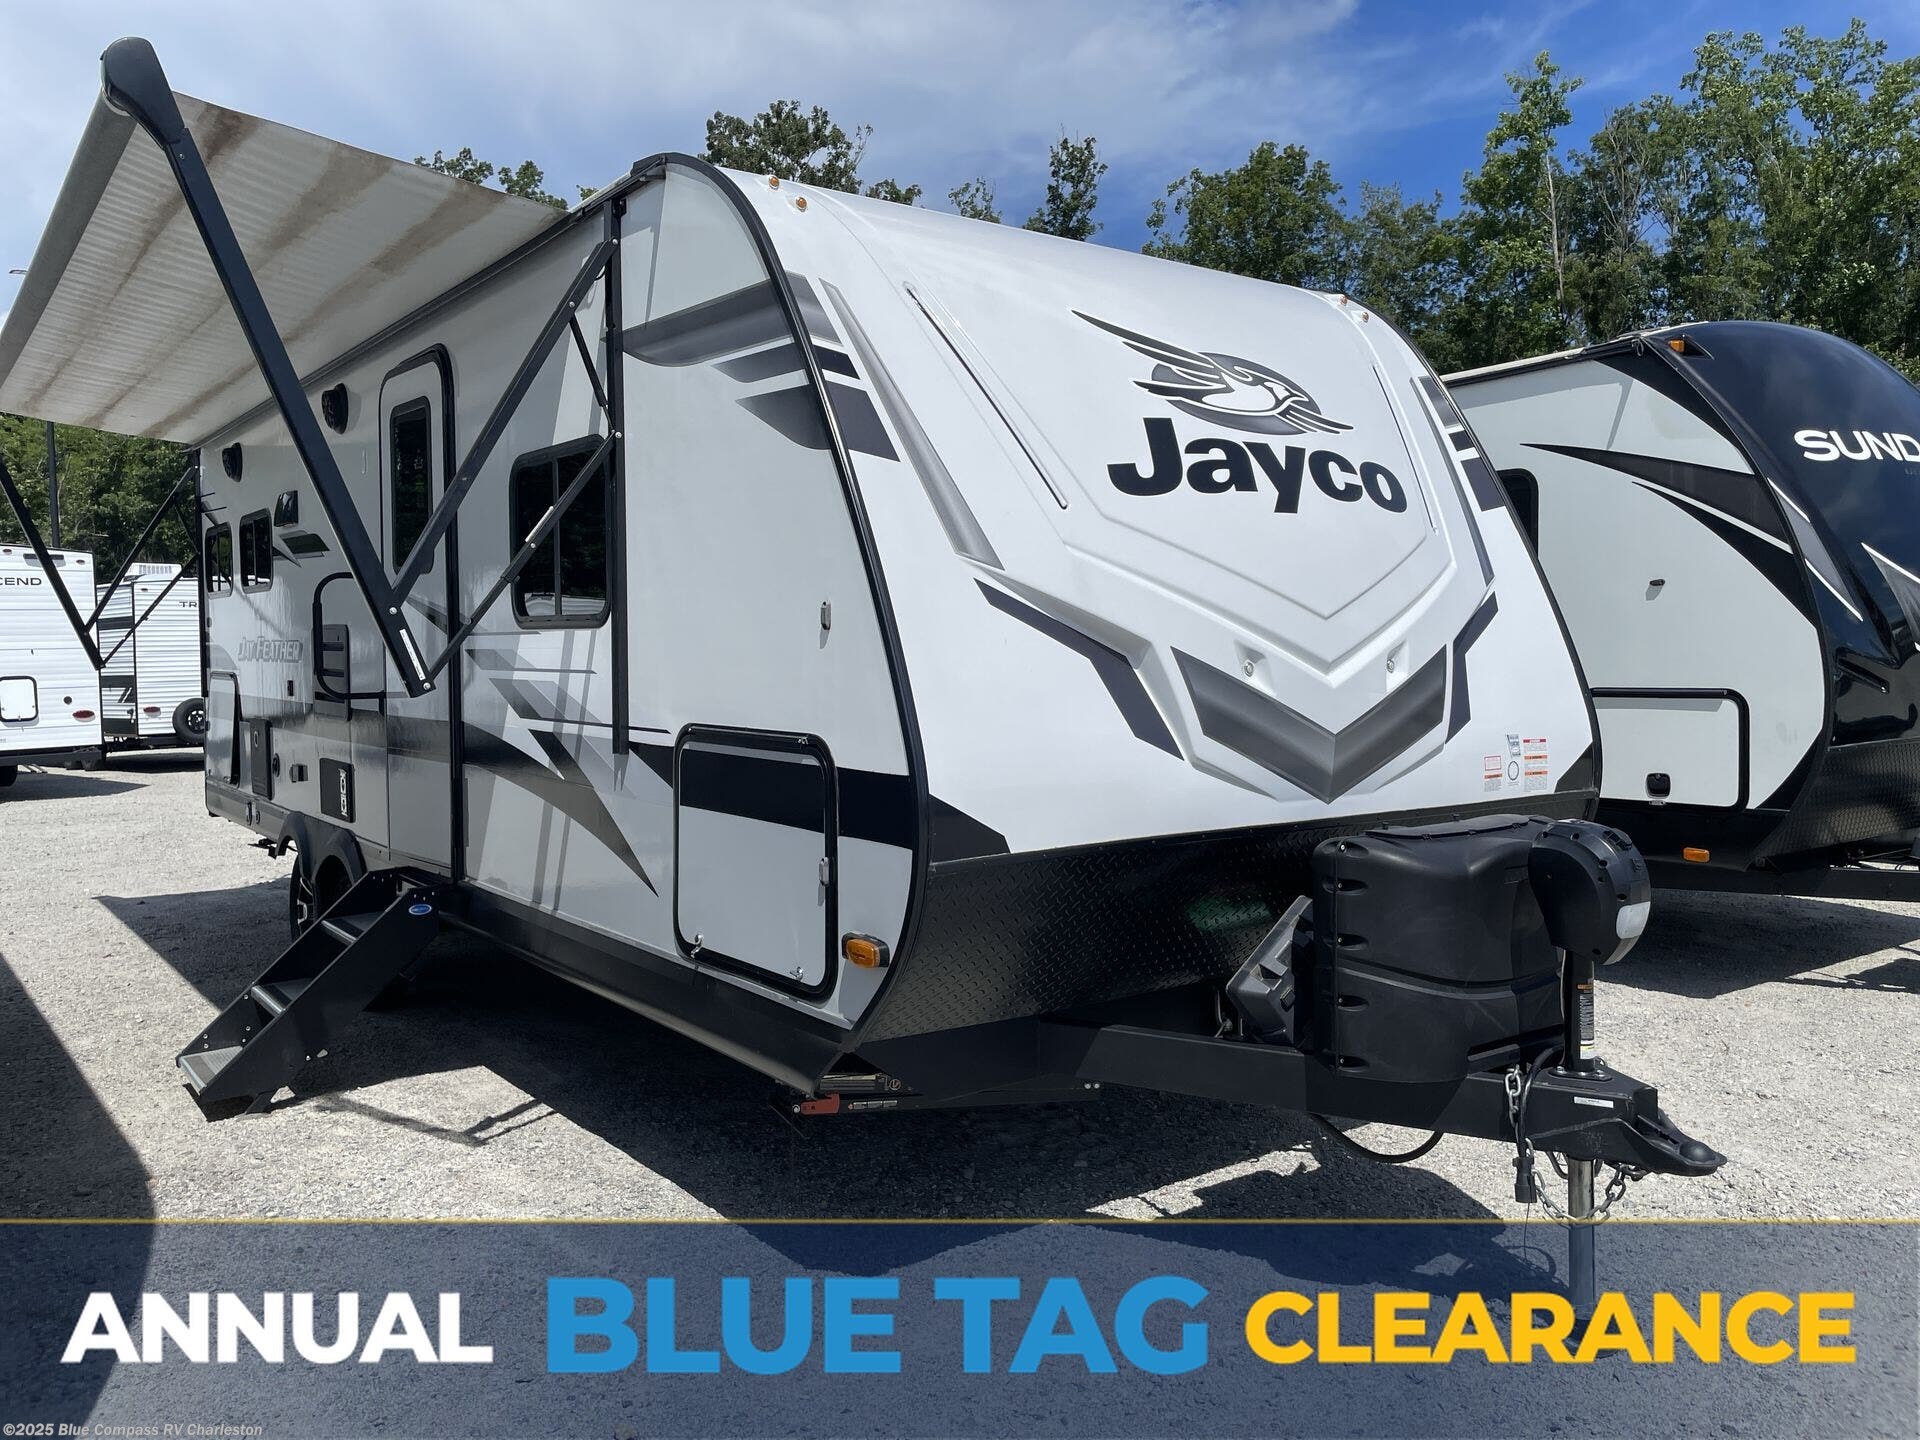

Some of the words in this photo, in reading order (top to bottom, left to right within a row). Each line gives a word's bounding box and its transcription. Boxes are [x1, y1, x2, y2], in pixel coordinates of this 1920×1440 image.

[1794, 429, 1920, 463] SUND
[1107, 417, 1407, 514] Jayco
[0, 577, 42, 585] END
